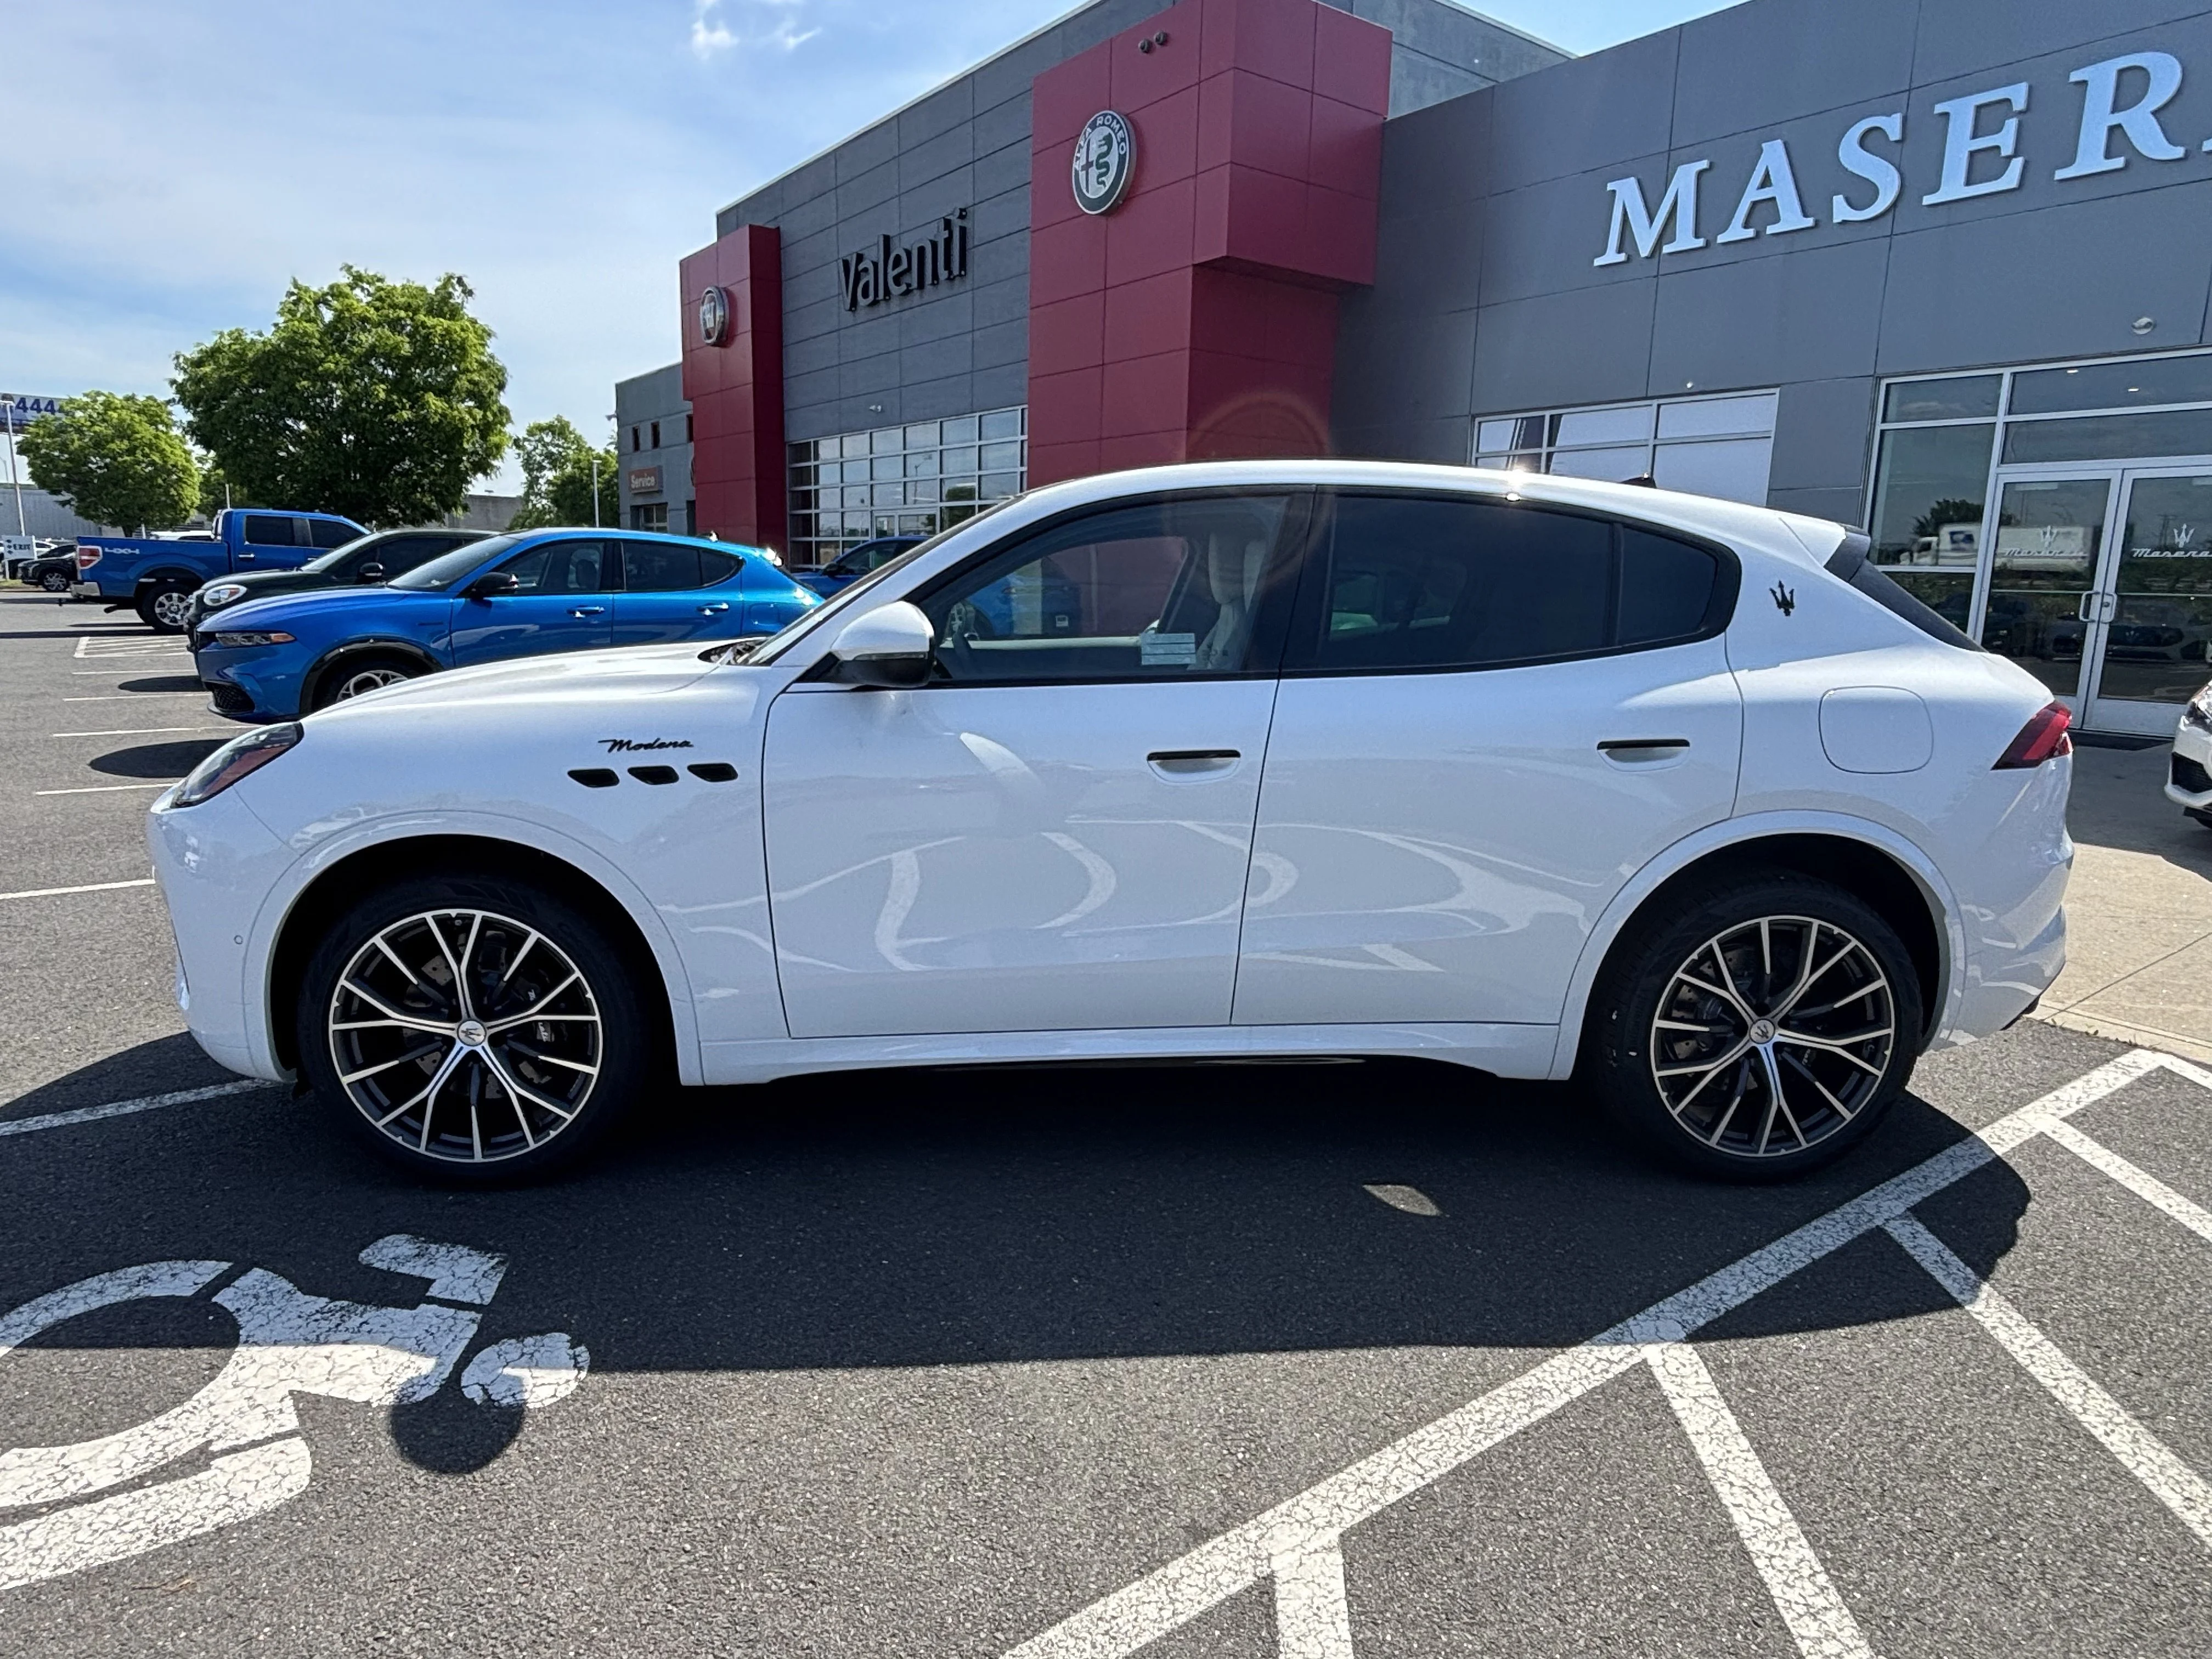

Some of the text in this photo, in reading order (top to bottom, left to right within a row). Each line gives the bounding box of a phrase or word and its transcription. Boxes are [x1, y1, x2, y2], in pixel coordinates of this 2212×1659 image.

[1096, 115, 1126, 155] ROMEO
[1593, 52, 2212, 267] MASER
[839, 207, 967, 312] Valenti
[631, 473, 655, 489] Service
[598, 738, 694, 753] Modena
